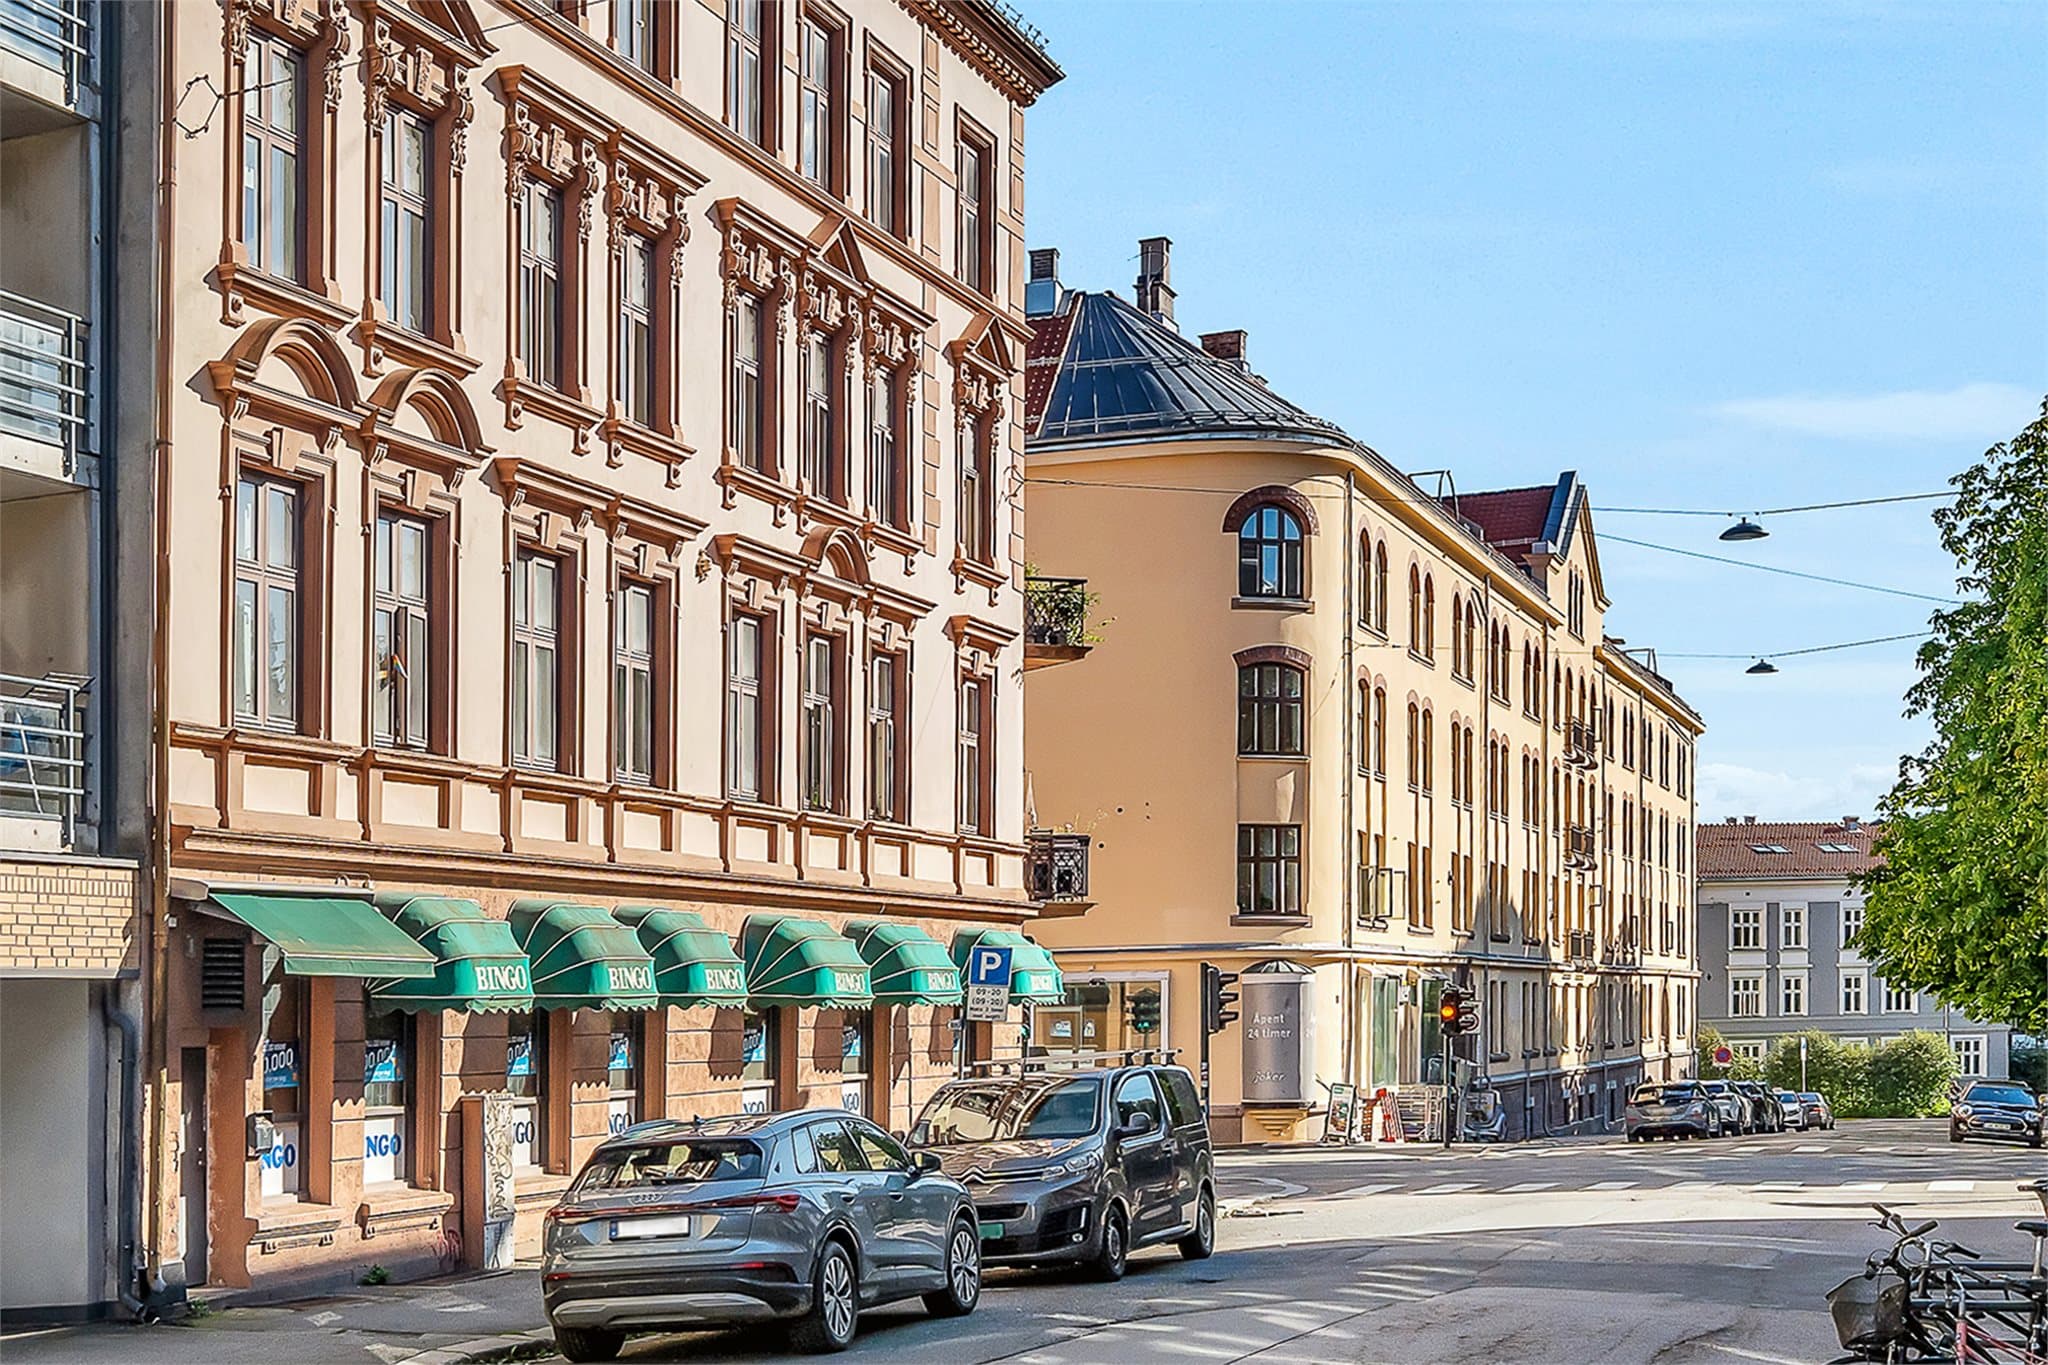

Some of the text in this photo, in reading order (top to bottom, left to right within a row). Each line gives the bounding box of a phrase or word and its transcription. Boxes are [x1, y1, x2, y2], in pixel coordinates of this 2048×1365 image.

[474, 964, 527, 991] BINGO
[608, 966, 652, 990] BINGO
[979, 951, 1002, 981] P
[704, 968, 744, 990] BINGO
[1262, 1027, 1292, 1039] timer
[365, 1134, 402, 1158] NGO
